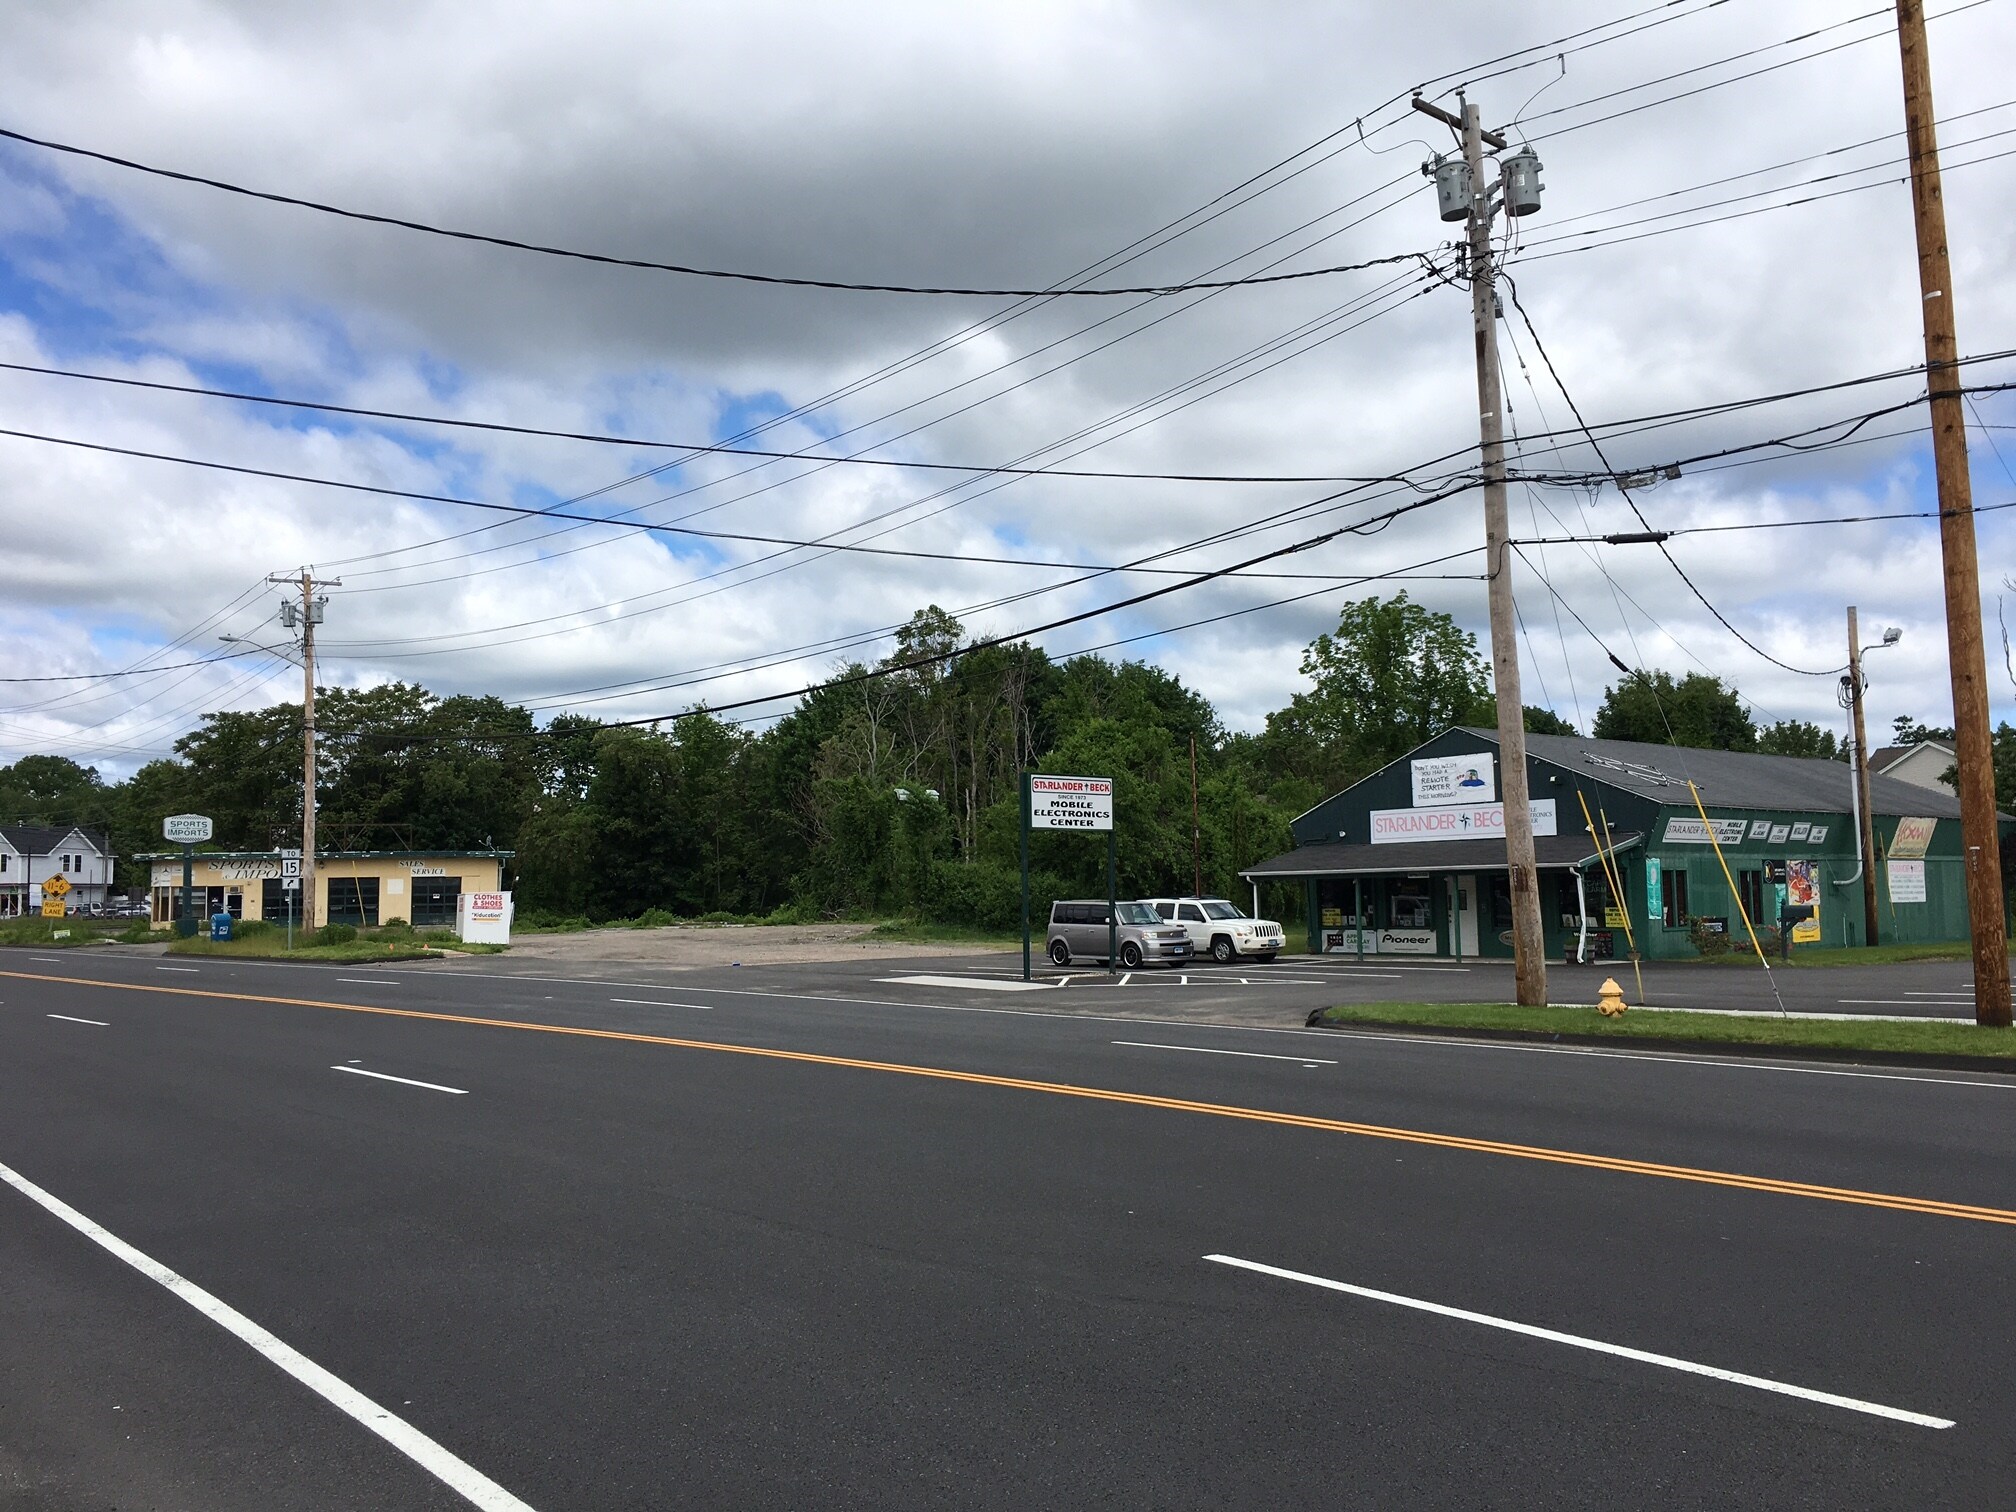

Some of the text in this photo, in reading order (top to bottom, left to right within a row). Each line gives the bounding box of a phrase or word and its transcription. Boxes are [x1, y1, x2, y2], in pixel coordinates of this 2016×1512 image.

[1034, 780, 1109, 792] STARLANDER BECK
[1420, 783, 1450, 791] STARTER
[1033, 809, 1109, 818] ELECTRONICS
[170, 820, 207, 828] SPORTS
[1050, 818, 1094, 826] CENTER
[1375, 810, 1504, 833] STARLANDER BEC
[208, 860, 276, 869] SPORTS
[285, 862, 296, 873] 15
[234, 869, 282, 879] IMPO
[1382, 933, 1430, 944] Pioneer
